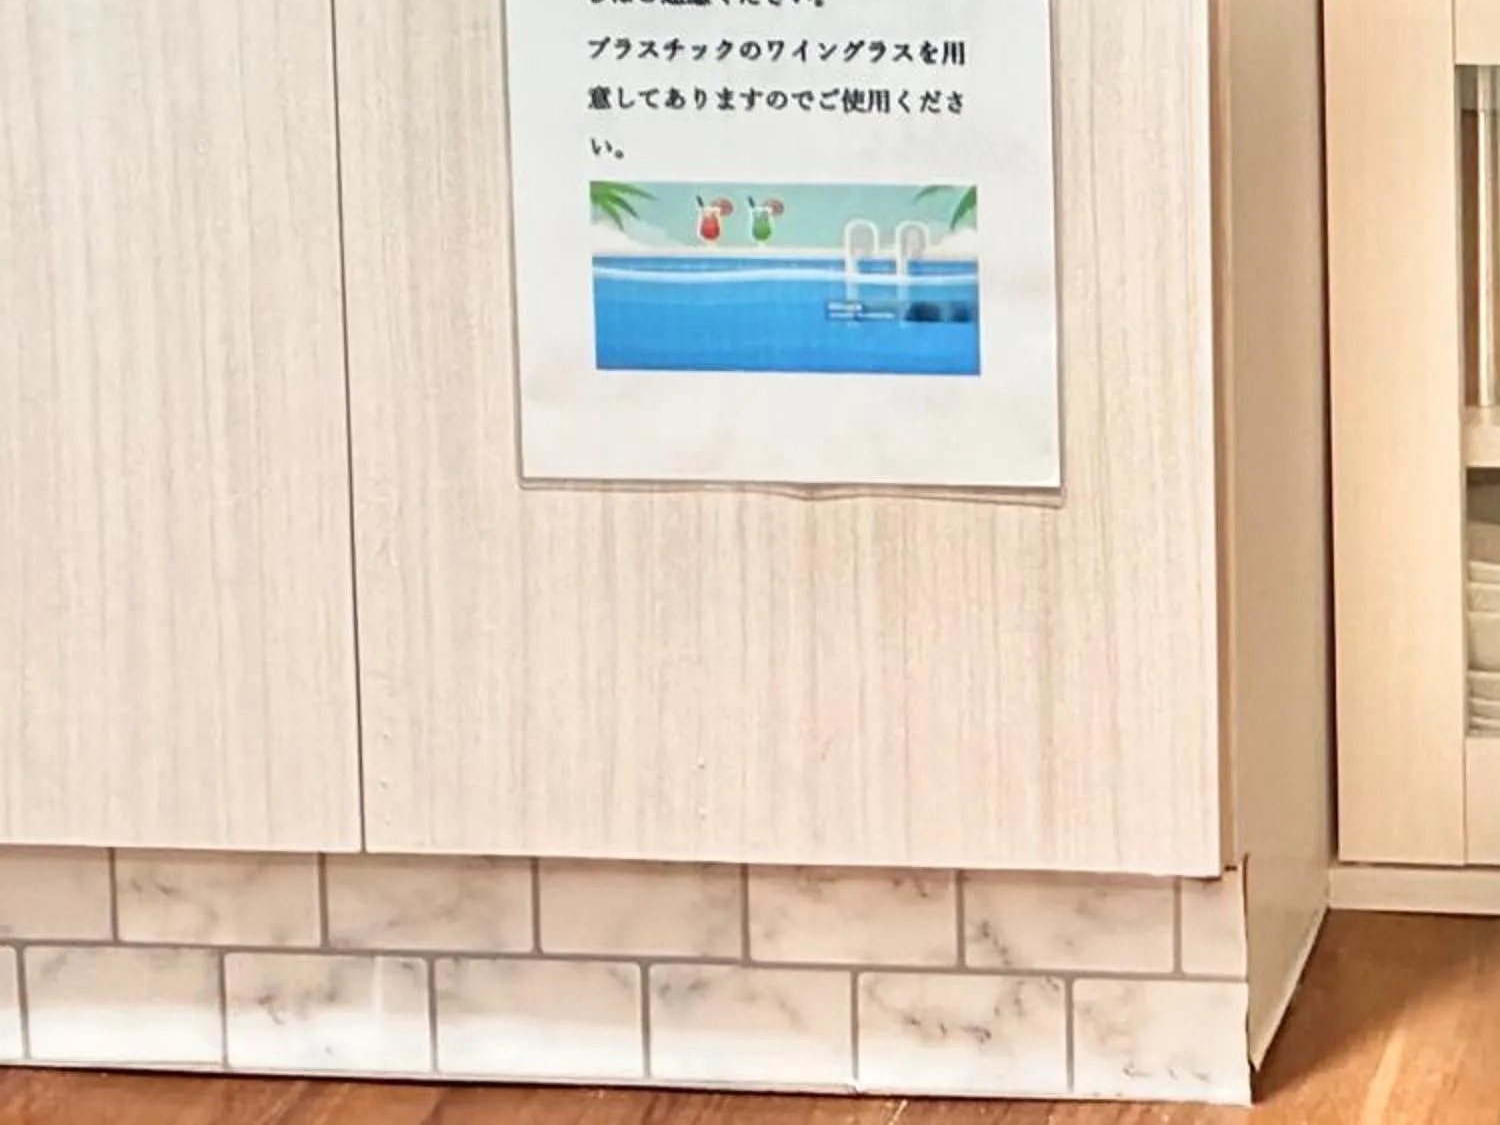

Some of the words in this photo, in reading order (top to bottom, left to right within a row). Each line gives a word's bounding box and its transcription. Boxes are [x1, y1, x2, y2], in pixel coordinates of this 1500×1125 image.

[588, 36, 965, 66] プラスチックのワイングラスを用
[588, 85, 963, 114] 意してありますのでご使用くださ
[591, 139, 624, 159] い。
